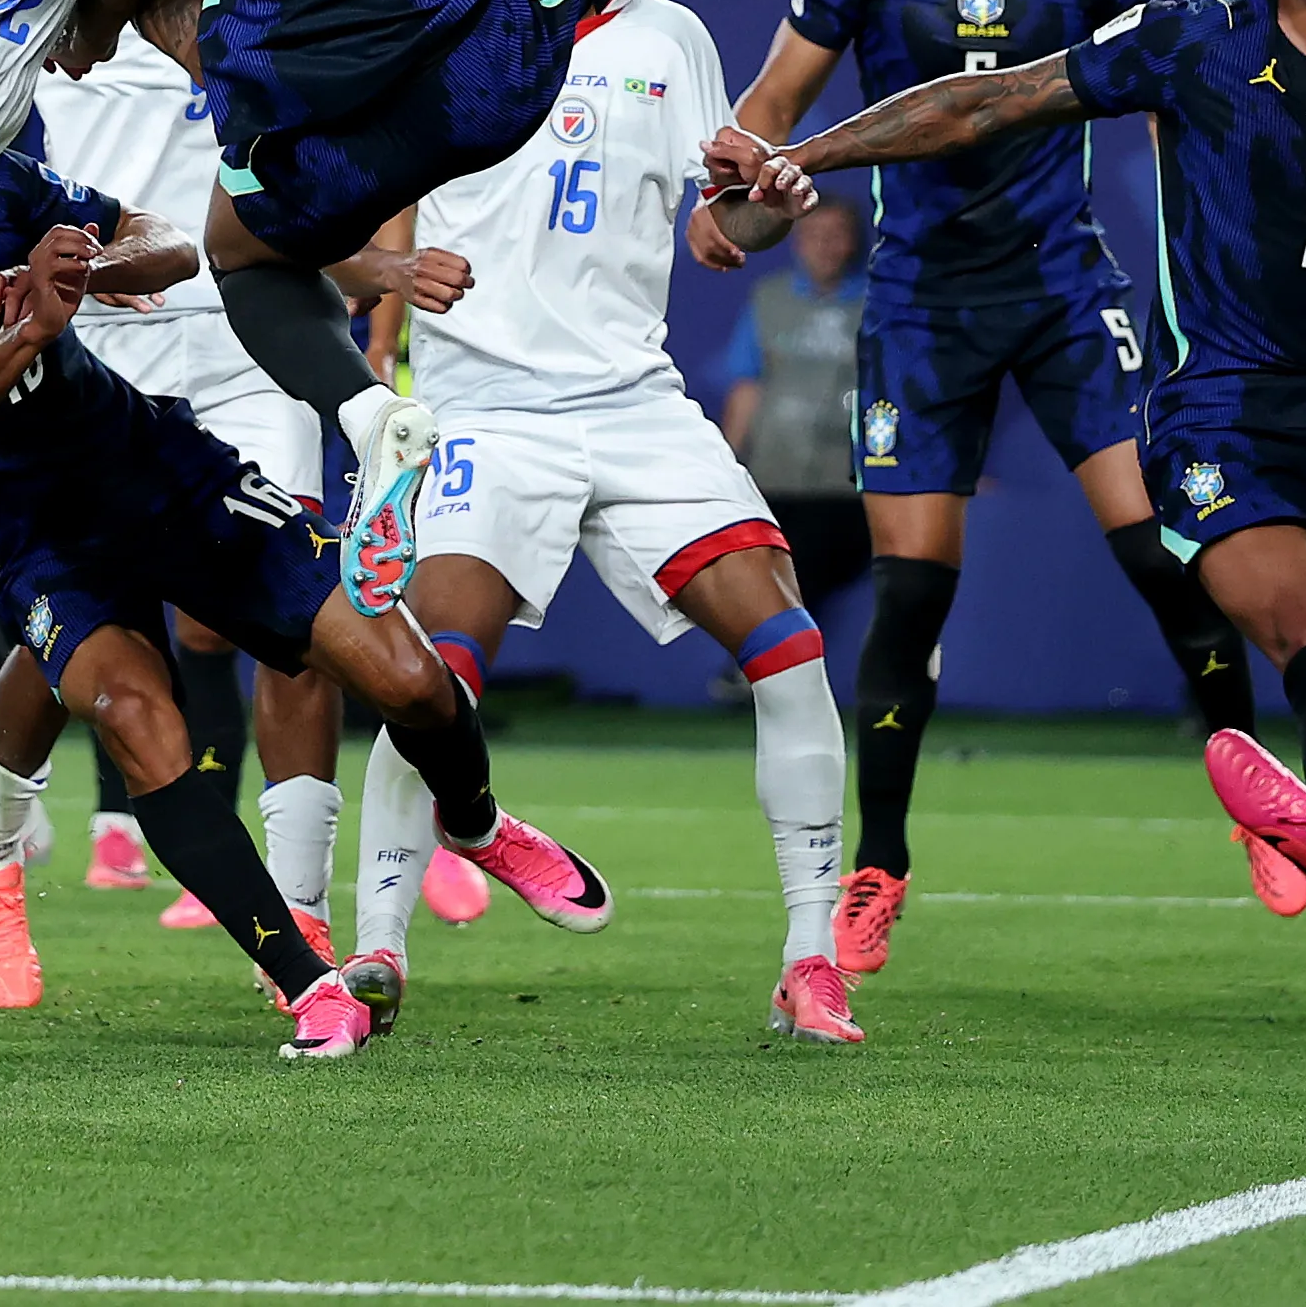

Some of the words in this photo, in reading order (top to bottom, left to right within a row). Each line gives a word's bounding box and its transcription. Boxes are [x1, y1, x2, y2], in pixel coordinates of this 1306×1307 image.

[957, 23, 1009, 38] BRASIL
[565, 74, 608, 88] ETA
[548, 158, 601, 235] 15
[1099, 307, 1143, 373] 5
[223, 471, 304, 529] 16
[1195, 495, 1236, 522] BRASIL
[42, 624, 65, 662] BRASIL
[377, 850, 410, 864] FHF
